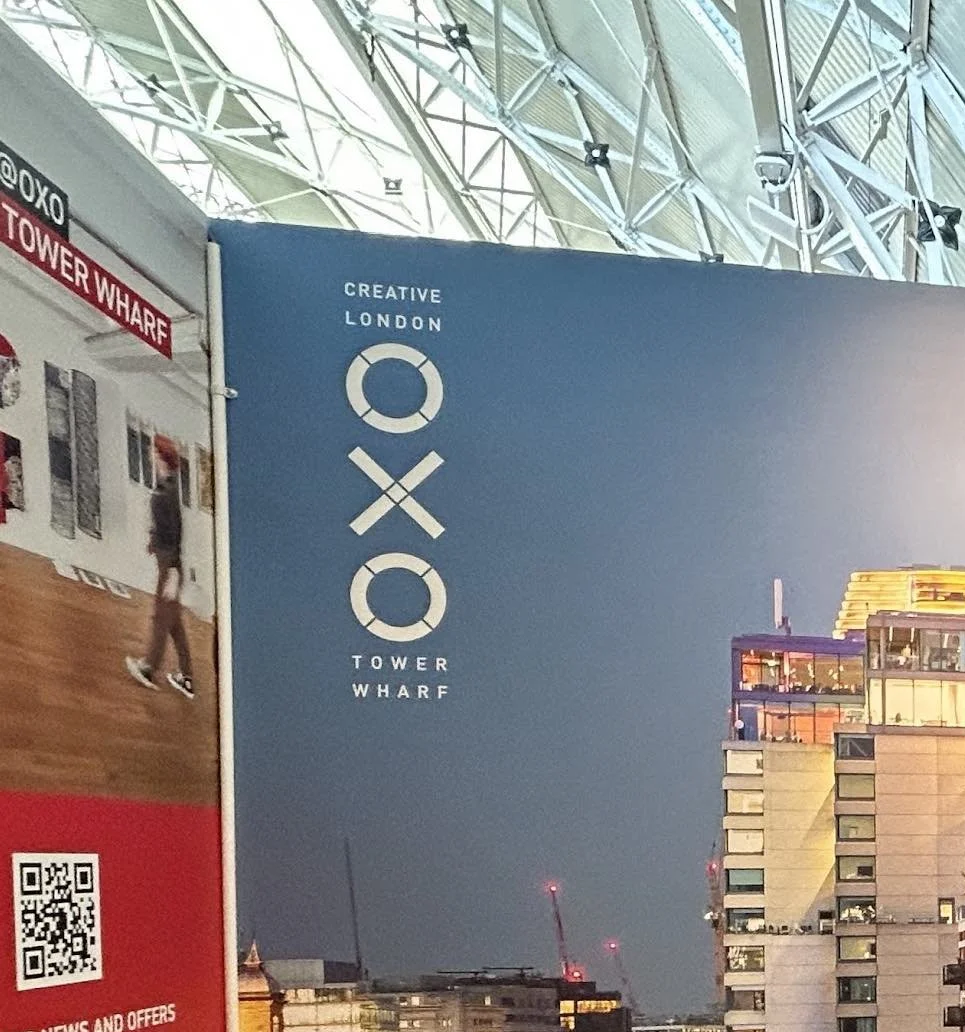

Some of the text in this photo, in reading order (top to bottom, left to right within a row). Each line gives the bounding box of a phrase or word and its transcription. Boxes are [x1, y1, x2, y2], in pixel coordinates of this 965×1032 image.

[1, 202, 169, 346] TOWER WHARF
[344, 281, 442, 304] CREATIVE
[345, 311, 442, 332] LONDON
[351, 655, 449, 672] TOWER
[352, 683, 449, 700] WHARF
[127, 1003, 176, 1030] OFFERS
